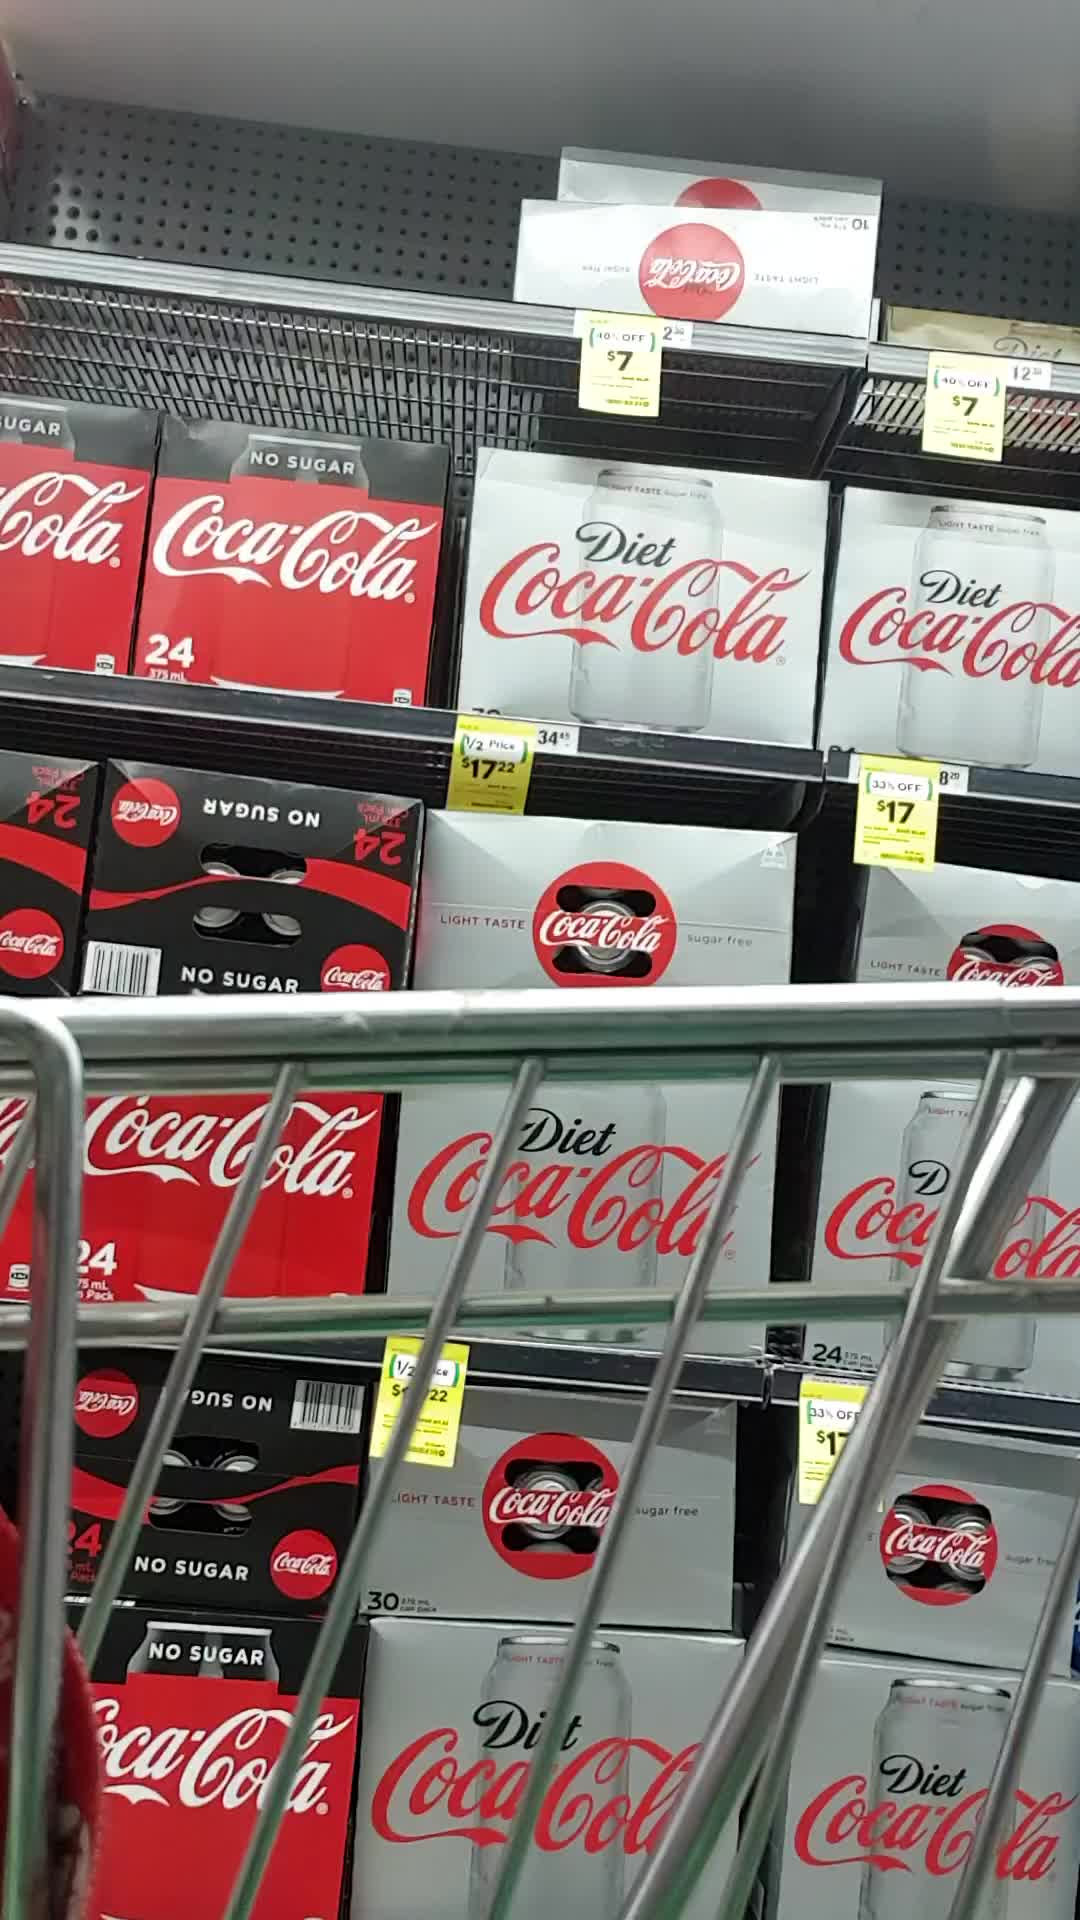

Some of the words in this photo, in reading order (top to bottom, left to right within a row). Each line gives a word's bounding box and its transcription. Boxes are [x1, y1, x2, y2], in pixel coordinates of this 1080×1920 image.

[851, 217, 870, 231] 10
[644, 257, 740, 290] Coca-Cola
[622, 334, 647, 342] OFF
[607, 350, 634, 371] $7
[952, 395, 979, 417] $7
[250, 450, 280, 467] NO
[287, 454, 356, 476] SUGAR
[153, 495, 438, 601] Coca-Cola
[575, 521, 676, 568] Diet
[920, 569, 1002, 608] Diet
[479, 542, 812, 663] Coca-Cola
[839, 586, 1080, 688] Coca-Cola
[145, 634, 195, 668] 24
[488, 740, 516, 750] Price
[897, 783, 921, 793] OFF
[26, 791, 80, 829] 24
[117, 800, 178, 827] Coca-Cola
[204, 798, 280, 823] SUGAR
[287, 810, 320, 828] NO
[876, 800, 916, 824] $17
[354, 827, 406, 866] 24
[440, 914, 478, 927] LIGHT
[485, 918, 526, 930] TASTE
[539, 909, 669, 953] Coca-Cola
[687, 933, 722, 946] sugar
[727, 934, 753, 947] free
[181, 965, 214, 985] NO
[223, 971, 299, 994] SUGAR
[324, 965, 389, 991] Coca-Cola
[870, 959, 902, 971] LIGHT
[907, 965, 941, 976] TASTE
[517, 1107, 617, 1156] Diet
[812, 1343, 842, 1363] 24
[76, 1389, 136, 1416] Coca-Cola
[191, 1390, 234, 1408] SUG
[241, 1395, 273, 1412] NO
[836, 1410, 861, 1421] OFF
[392, 1493, 428, 1504] IGHT
[434, 1495, 475, 1508] TASTE
[488, 1486, 618, 1528] Coca-Cola
[673, 1505, 699, 1516] free
[884, 1523, 993, 1568] Coca-Cola
[134, 1556, 166, 1573] NO
[175, 1559, 249, 1581] SUGAR
[272, 1551, 331, 1576] Coca-Cola
[367, 1591, 400, 1611] 30
[148, 1643, 182, 1661] NO
[189, 1646, 265, 1666] SUGAR
[473, 1700, 582, 1751] Dit
[880, 1754, 966, 1797] Diet
[371, 1727, 703, 1855] CocaCol
[794, 1775, 1080, 1881] Coca-Cla
